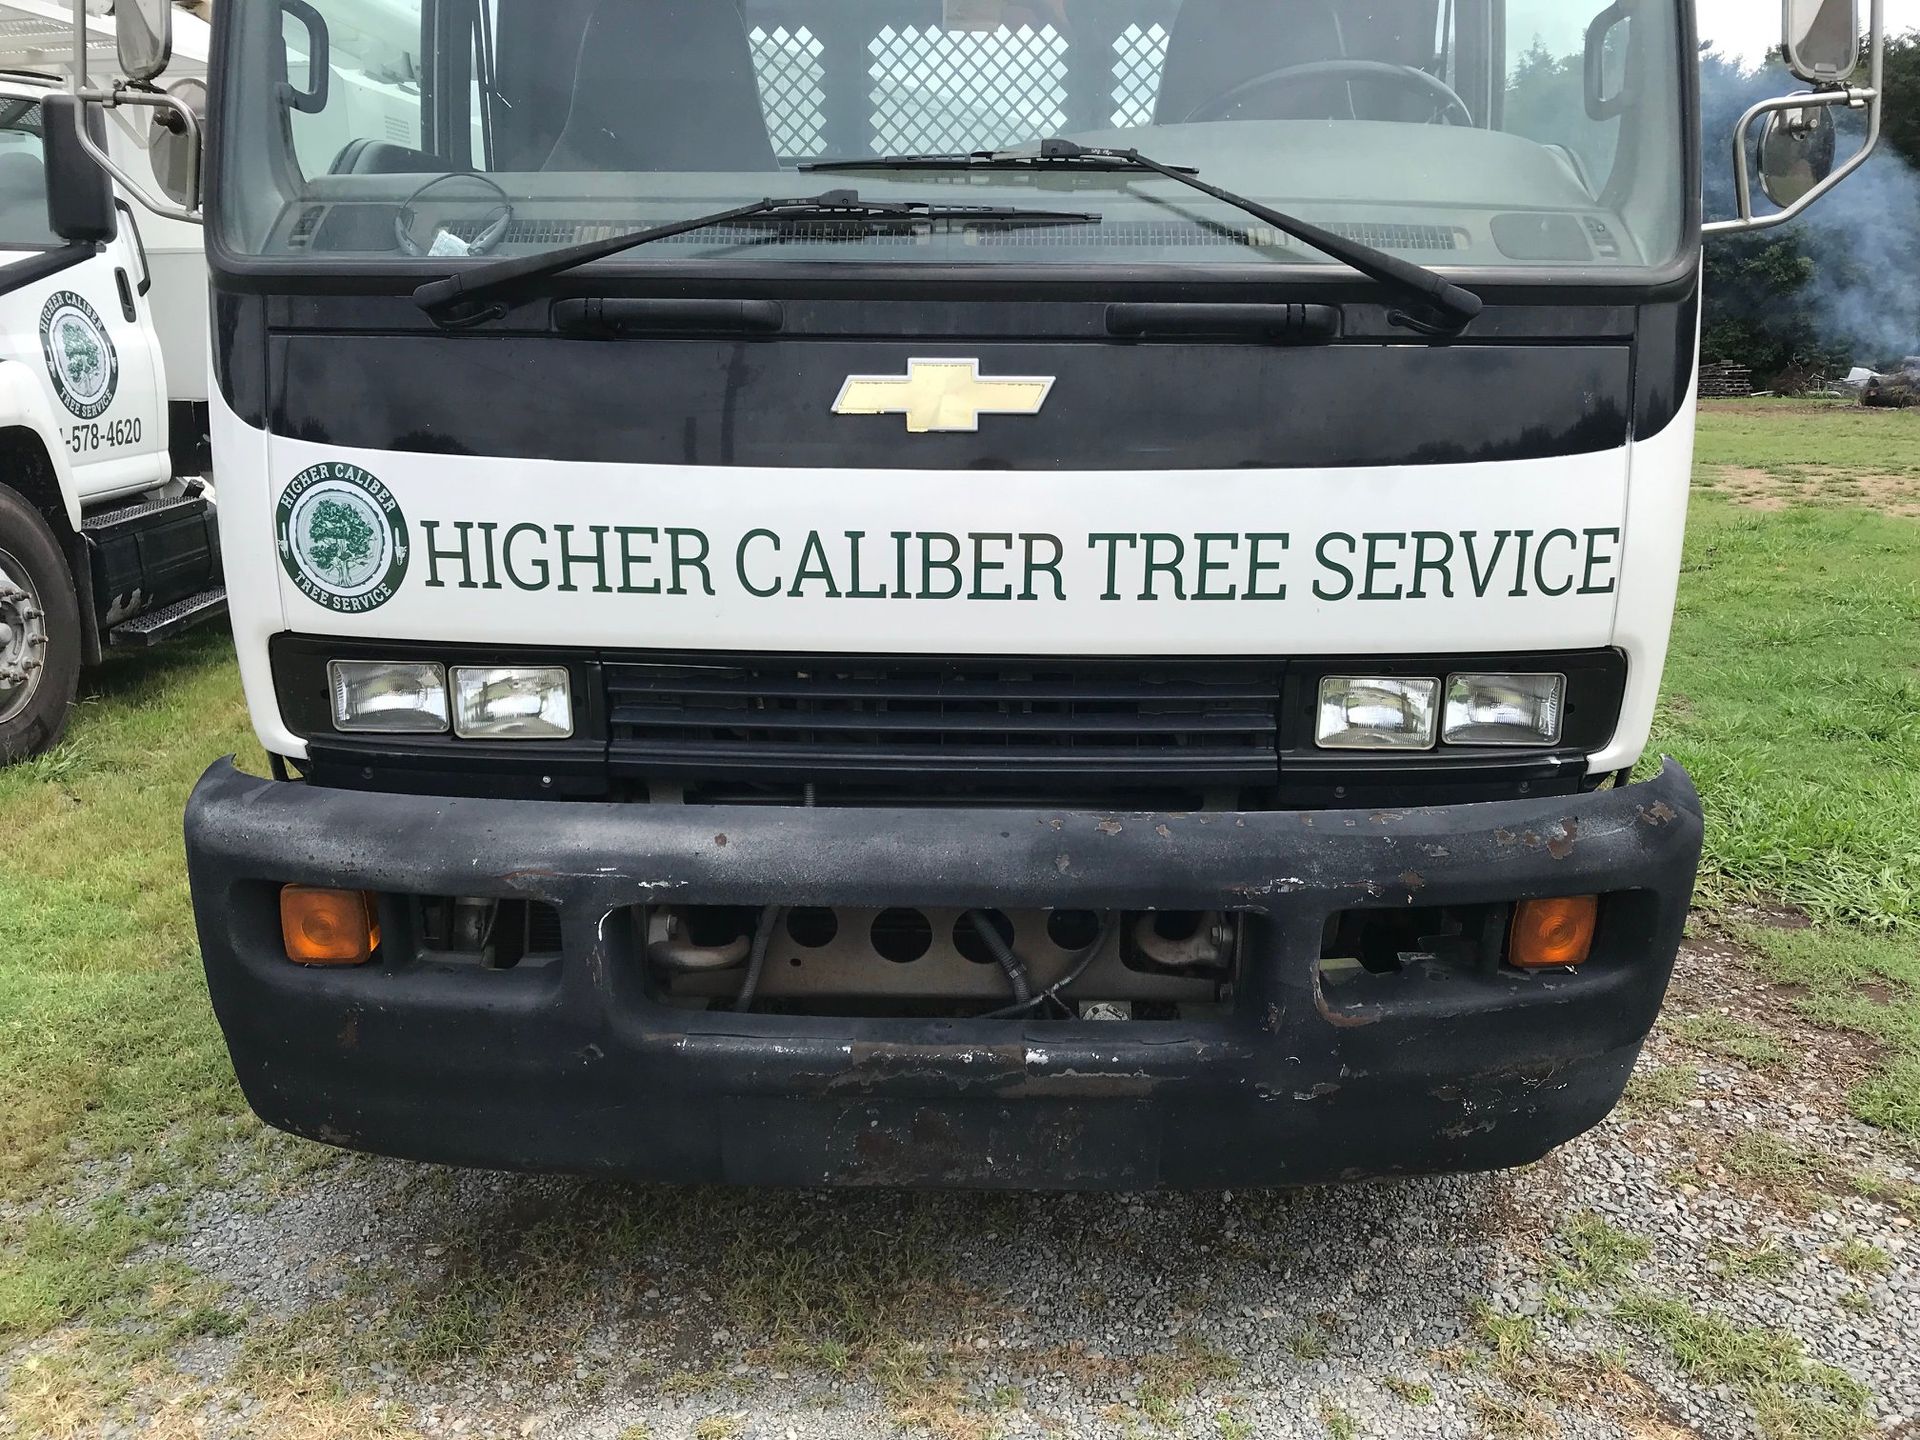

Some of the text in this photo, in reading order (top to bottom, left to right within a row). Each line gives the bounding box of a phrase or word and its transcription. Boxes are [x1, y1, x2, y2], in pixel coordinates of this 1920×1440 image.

[40, 292, 104, 334] HIGHER CALIBER
[59, 387, 113, 418] TREE SERVICE
[281, 463, 397, 513] HIGHER CALIBER
[420, 520, 1620, 602] HIGHER CALIBER TREE SERVICE
[294, 570, 393, 611] TREE SERVICE
